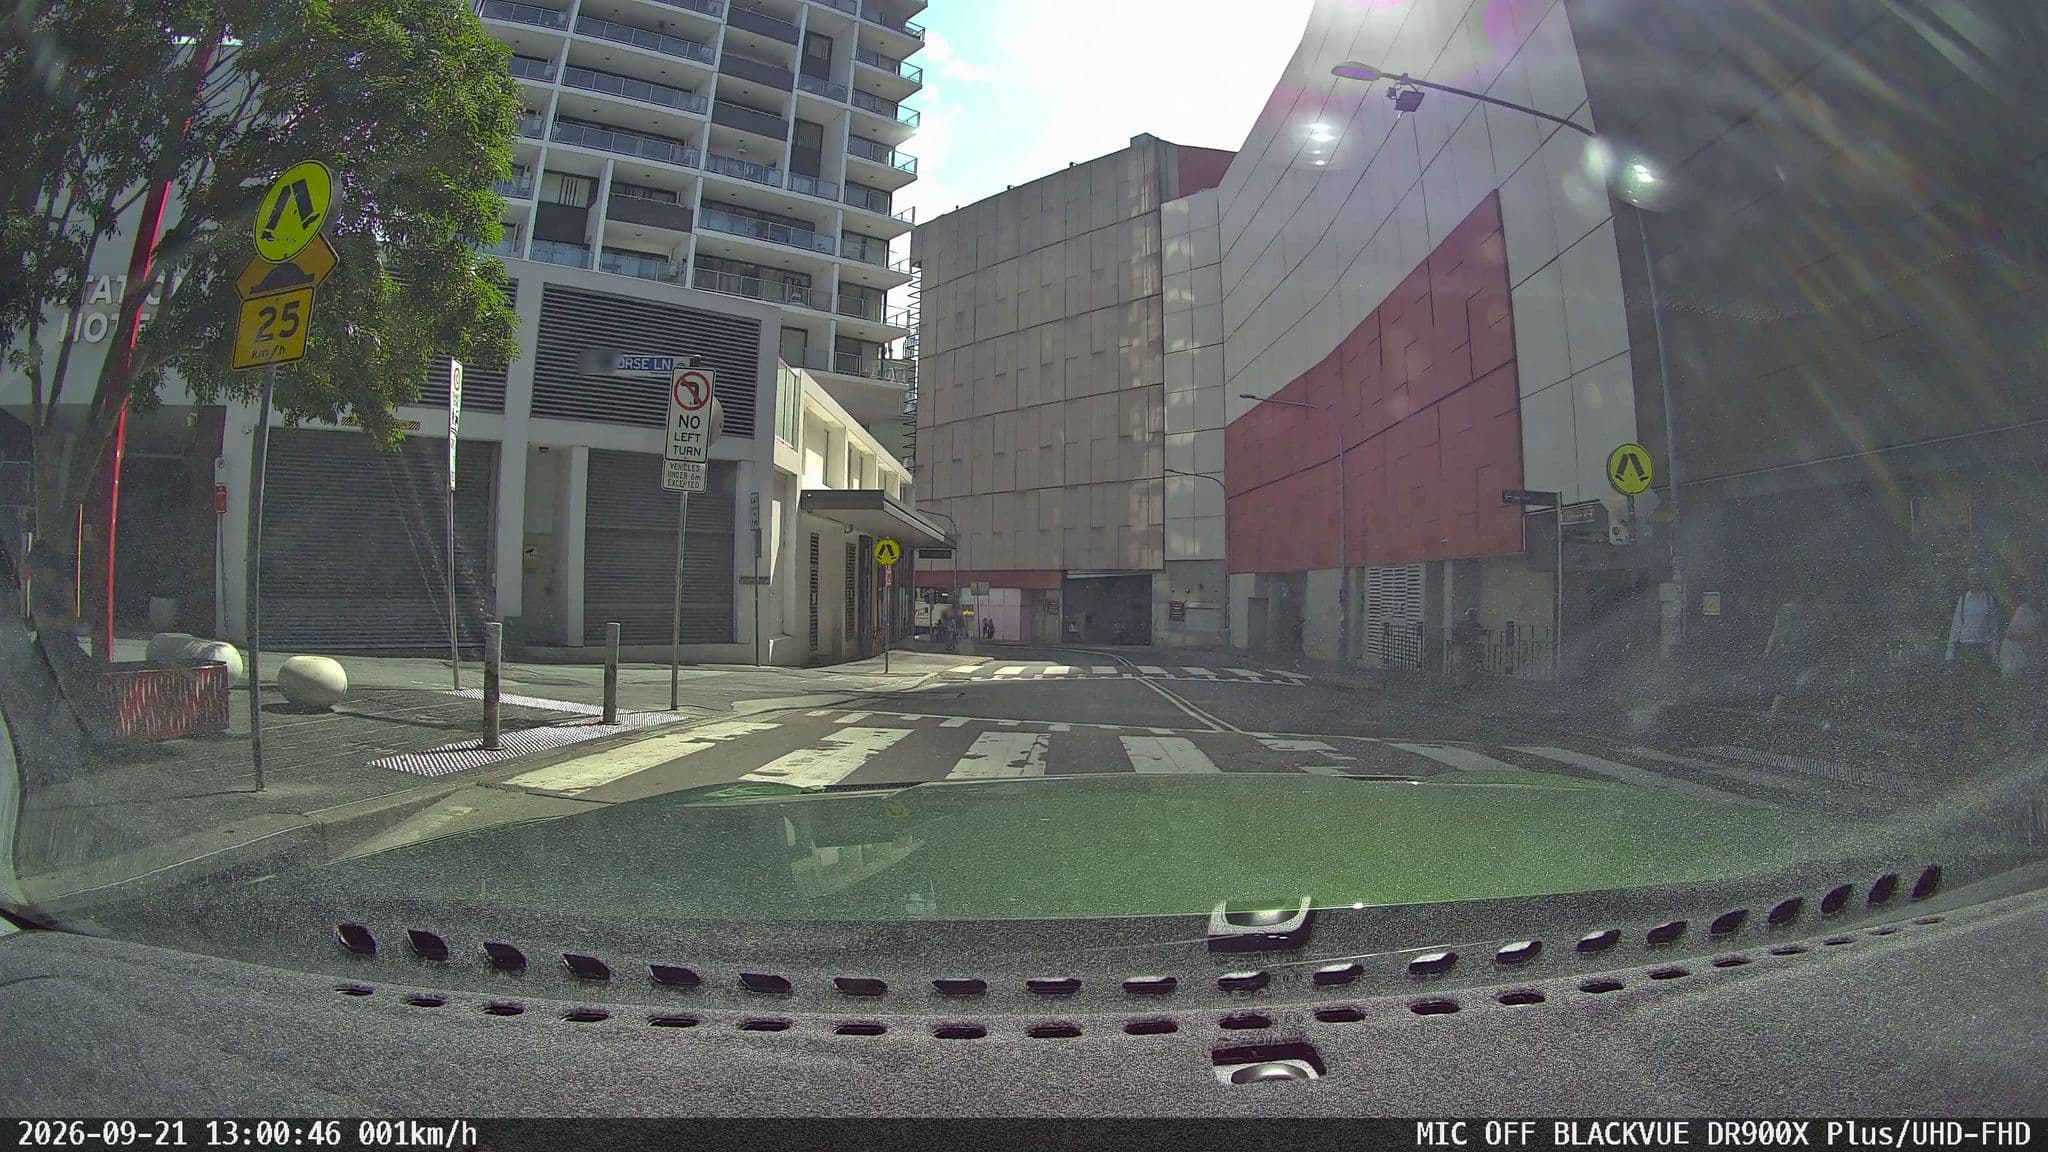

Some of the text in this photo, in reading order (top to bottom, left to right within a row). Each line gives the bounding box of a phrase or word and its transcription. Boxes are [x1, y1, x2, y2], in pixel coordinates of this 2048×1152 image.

[255, 300, 300, 342] 25
[251, 345, 286, 359] km/h
[654, 358, 672, 371] LN
[678, 414, 701, 430] NO
[674, 432, 701, 443] LEFT
[672, 444, 702, 457] TURN
[669, 462, 701, 473] VEHICLES
[667, 470, 701, 481] UNDER 6m
[667, 478, 700, 489] EXCEPTED
